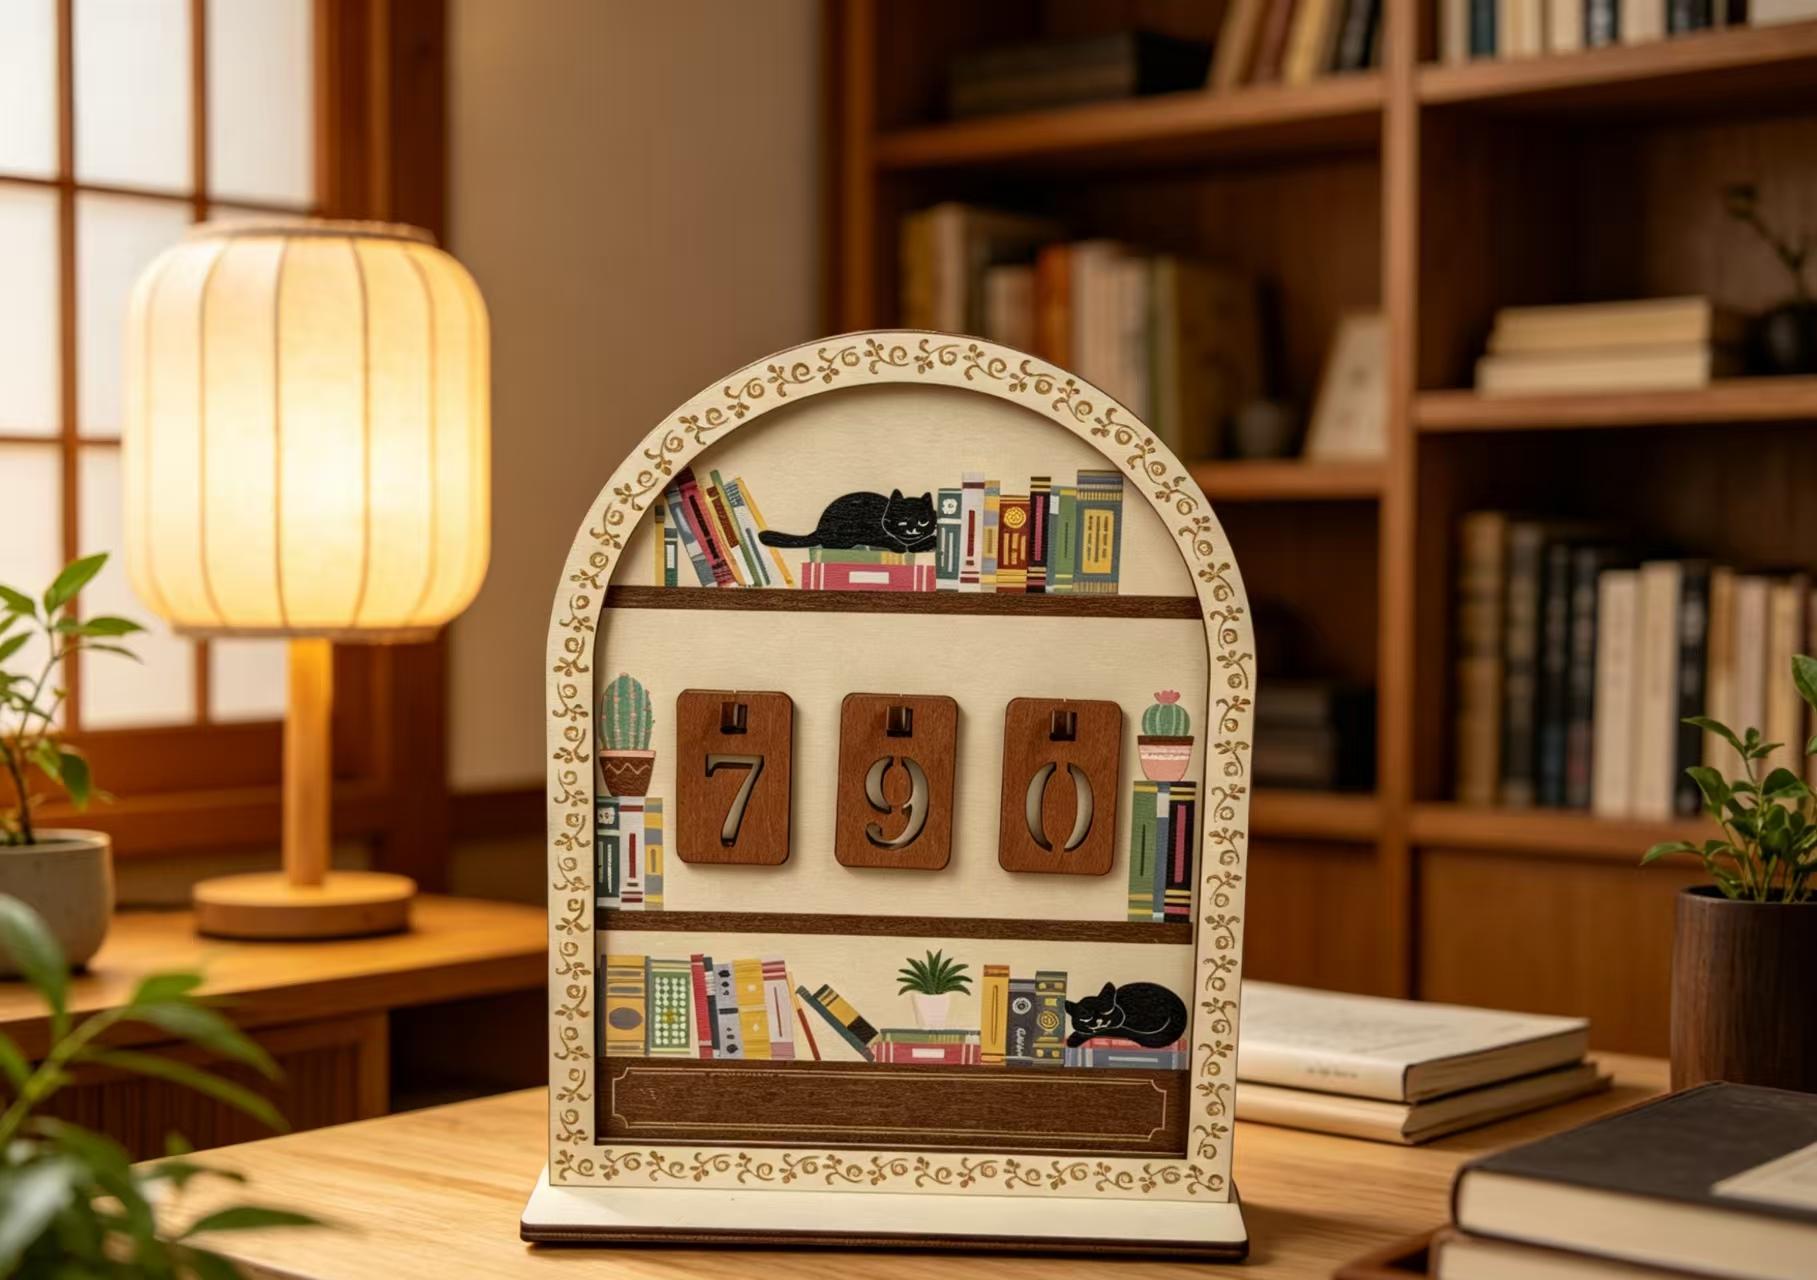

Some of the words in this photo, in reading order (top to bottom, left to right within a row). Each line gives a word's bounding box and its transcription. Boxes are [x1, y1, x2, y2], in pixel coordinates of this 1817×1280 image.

[705, 754, 764, 848] 7
[865, 755, 930, 850] 9
[1025, 761, 1094, 852] 0
